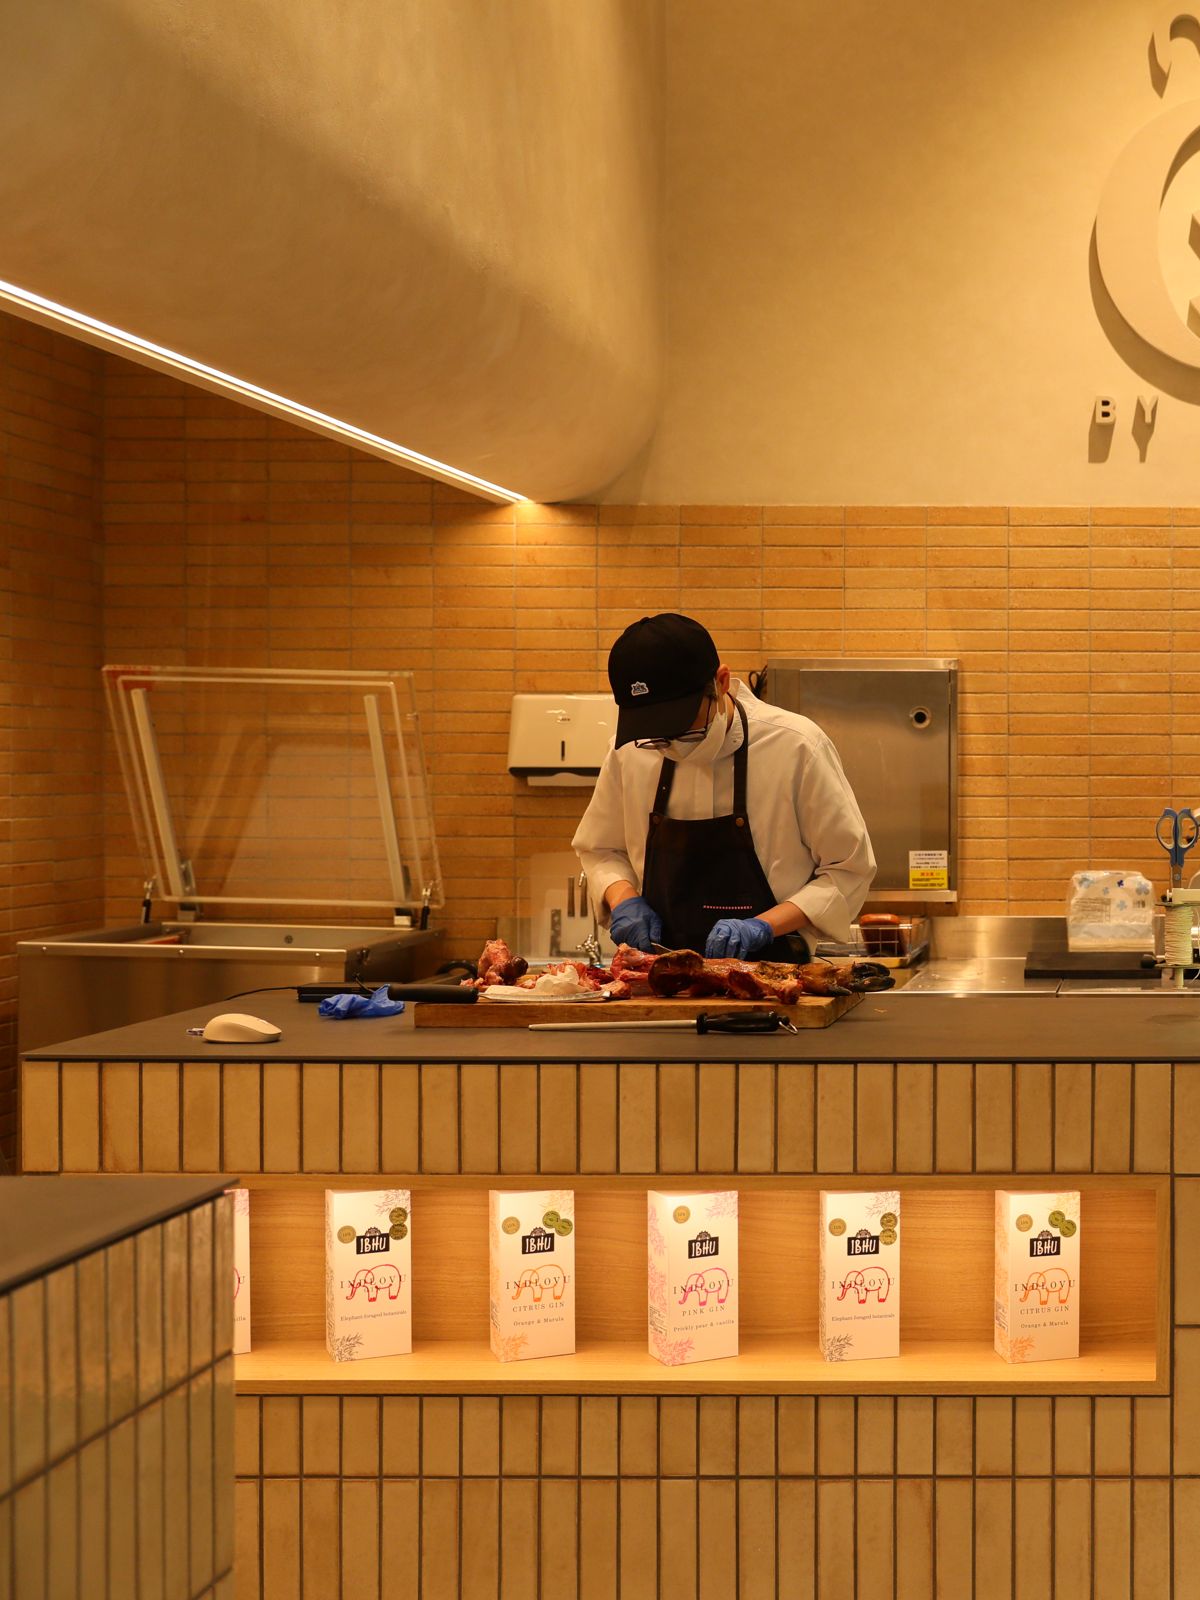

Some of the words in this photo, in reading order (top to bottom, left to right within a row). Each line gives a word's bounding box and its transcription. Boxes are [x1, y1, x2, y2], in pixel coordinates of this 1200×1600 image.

[1094, 395, 1158, 423] BY
[360, 1237, 386, 1253] IBHU
[526, 1237, 551, 1253] IBHU
[691, 1240, 716, 1257] IBHU
[850, 1238, 877, 1254] IBHU
[1033, 1240, 1058, 1256] IBHU
[340, 1274, 406, 1289] INDLOVU
[506, 1275, 571, 1290] INDLOVU
[673, 1278, 735, 1295] INDLOVU
[831, 1277, 895, 1290] INDLOVU
[1014, 1279, 1076, 1292] INDLOVU
[512, 1303, 546, 1313] CITRUS
[682, 1307, 705, 1317] PINK
[709, 1305, 726, 1313] GIN
[1020, 1306, 1052, 1315] CITRUS
[1054, 1305, 1070, 1313] GIN
